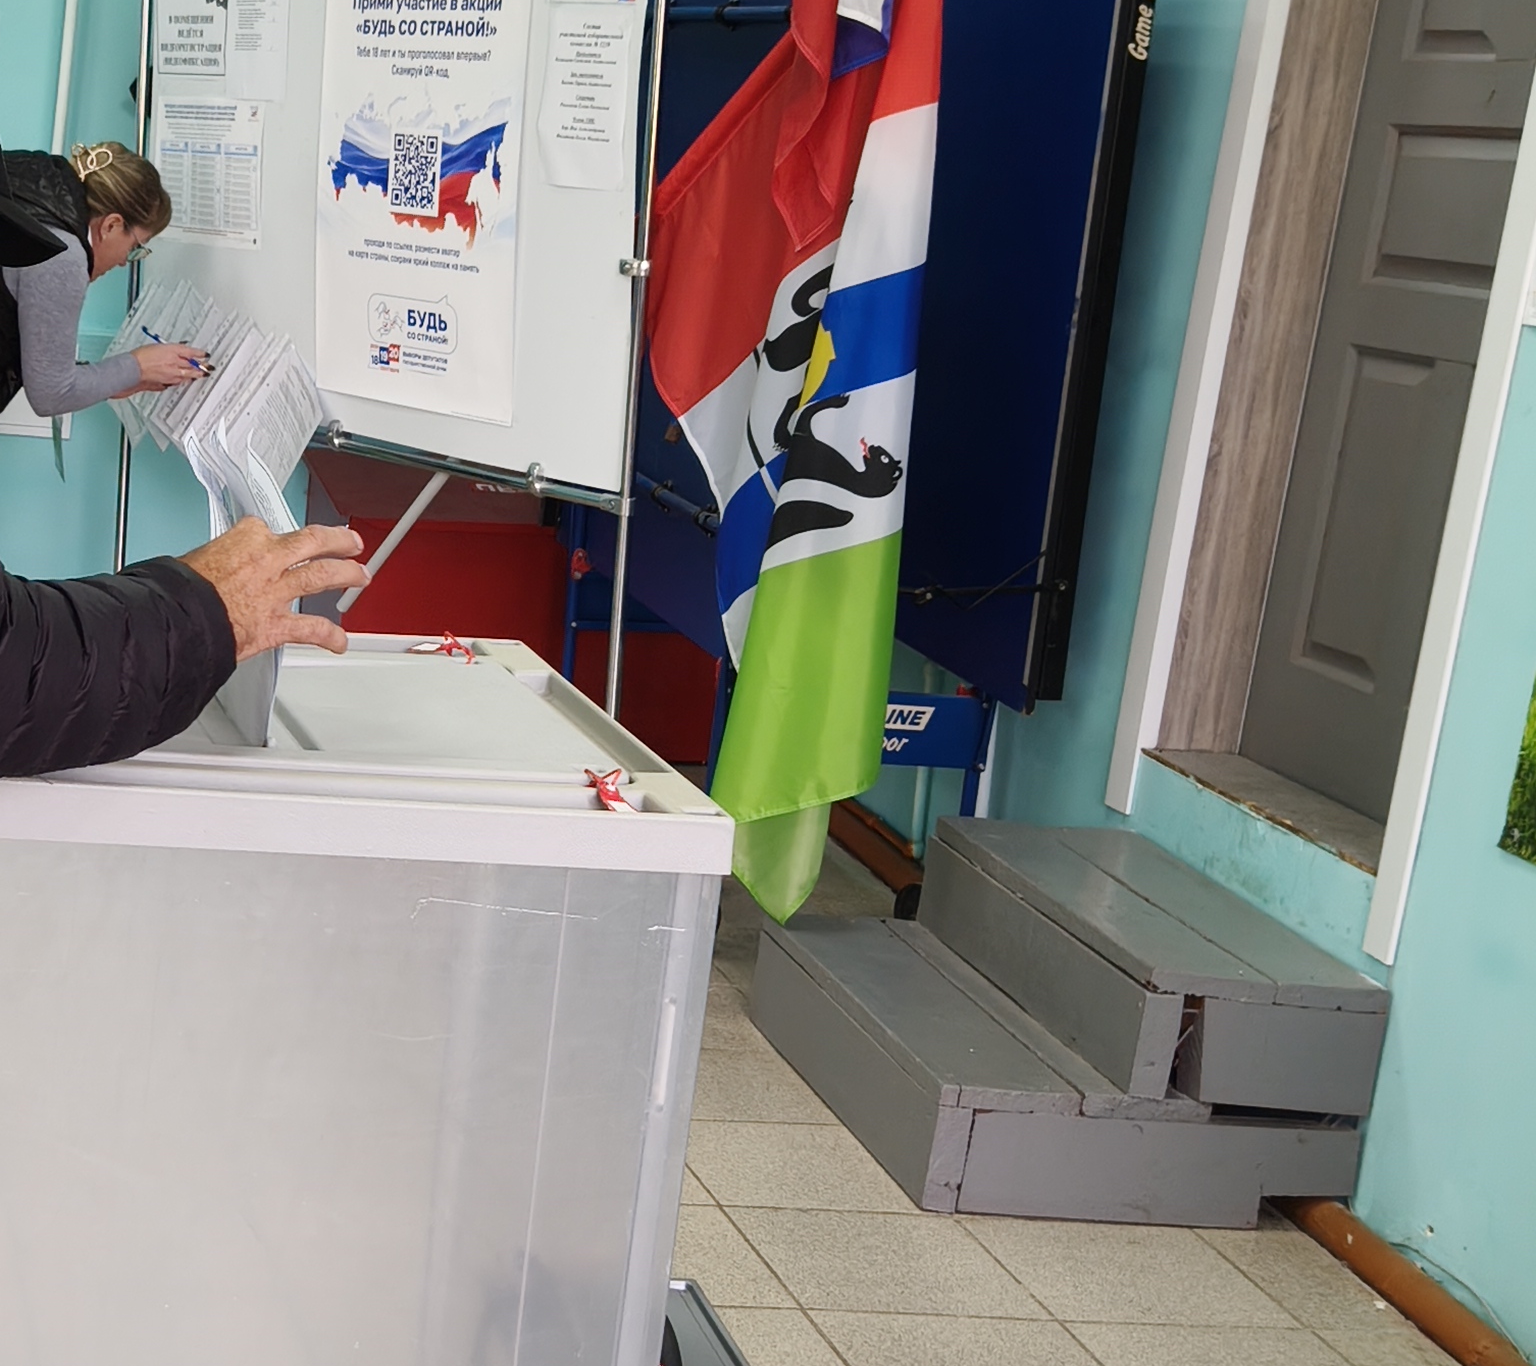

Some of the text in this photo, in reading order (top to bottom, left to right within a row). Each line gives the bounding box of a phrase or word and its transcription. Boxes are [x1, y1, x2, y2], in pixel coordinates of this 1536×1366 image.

[356, 17, 498, 38] «БУДЬ СО СТРАНОЙ!»
[1127, 4, 1154, 61] Game
[356, 46, 371, 57] Тебе
[372, 47, 379, 58] 18
[379, 48, 391, 58] лет
[397, 49, 406, 59] ты
[407, 50, 455, 61] проголосовал
[456, 50, 492, 63] впервые?
[391, 64, 423, 78] Сканируй
[406, 309, 448, 334] БУДЬ
[407, 331, 416, 340] СО
[371, 355, 379, 365] 18
